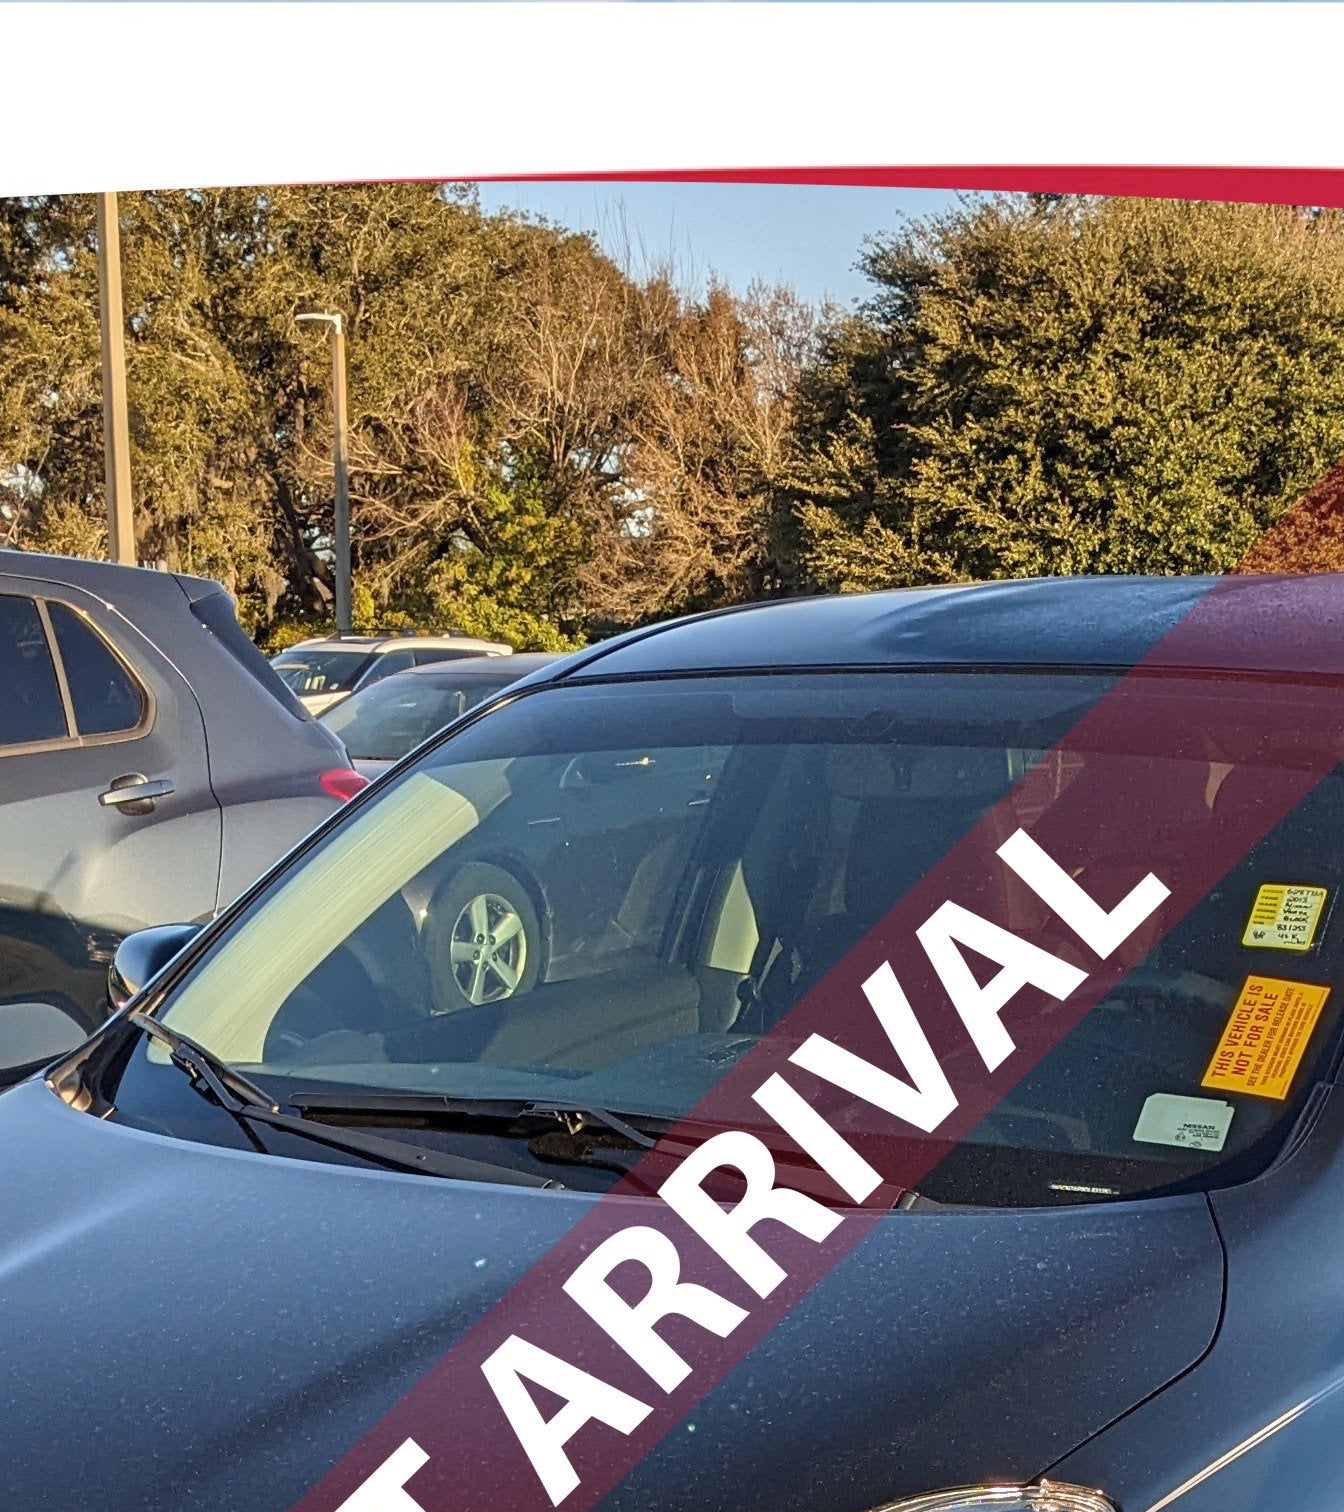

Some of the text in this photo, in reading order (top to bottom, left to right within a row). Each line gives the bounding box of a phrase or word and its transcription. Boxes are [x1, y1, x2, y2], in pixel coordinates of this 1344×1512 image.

[1210, 984, 1263, 1078] THIS VEHICLE IS
[1231, 992, 1278, 1075] NOT FOR SALE
